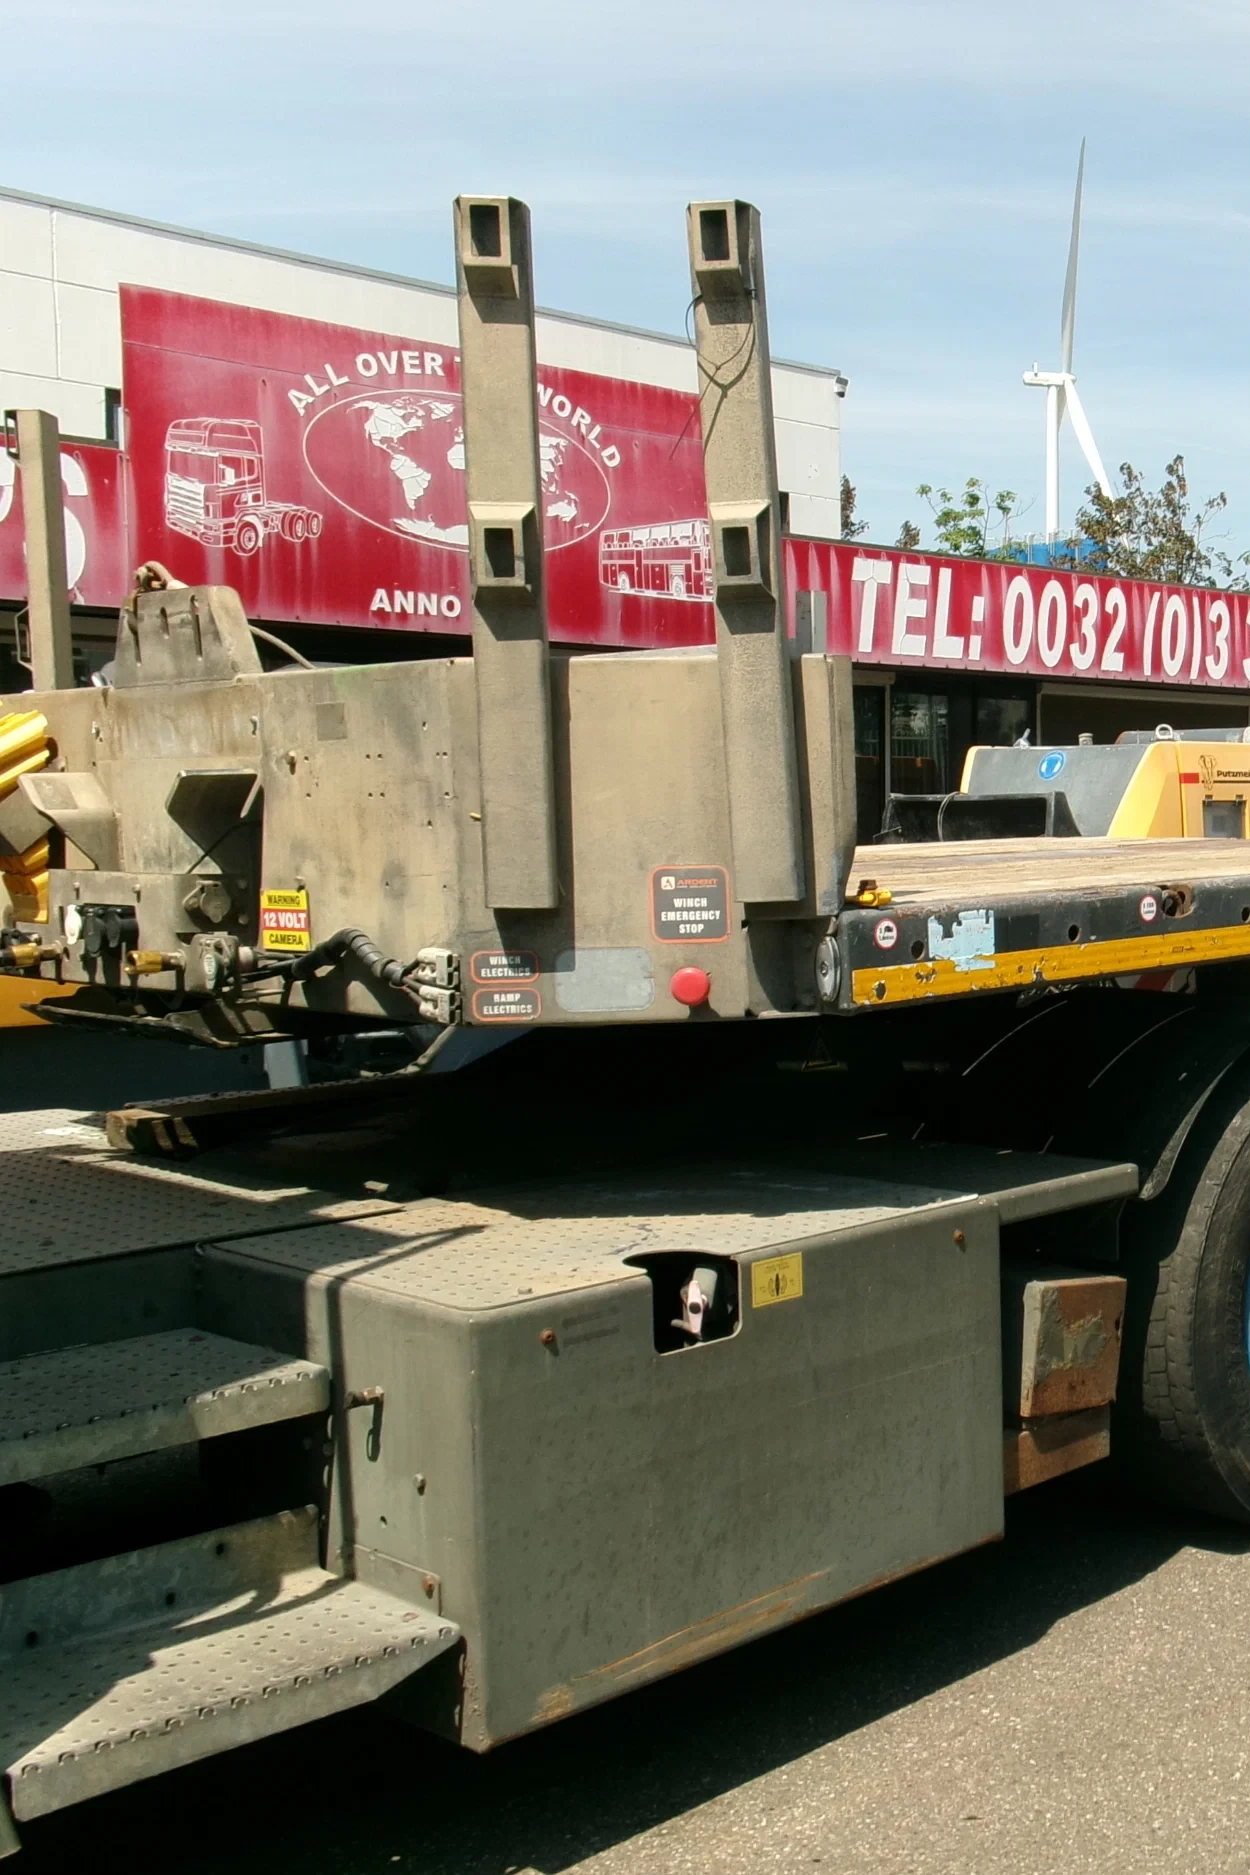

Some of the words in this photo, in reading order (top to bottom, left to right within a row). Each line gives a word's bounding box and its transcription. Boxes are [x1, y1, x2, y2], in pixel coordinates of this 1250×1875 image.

[287, 363, 350, 417] ALL
[355, 350, 445, 378] OVER
[370, 588, 461, 618] ANNO
[852, 557, 985, 661] TEL:
[1003, 575, 1127, 671] 0032
[1143, 591, 1231, 680] (0)3
[676, 878, 718, 886] ARDENT
[267, 894, 301, 906] WARNING
[673, 897, 708, 908] WINCH
[263, 912, 277, 928] 12
[278, 912, 306, 929] VOLT
[661, 910, 720, 921] EMERGENCY
[679, 923, 704, 934] STOP
[269, 933, 303, 945] CAMERA
[489, 956, 521, 965] WINCH
[481, 967, 531, 977] ELECTRICS
[494, 993, 521, 1003] RAMP
[483, 1005, 532, 1015] ELECTRICS
